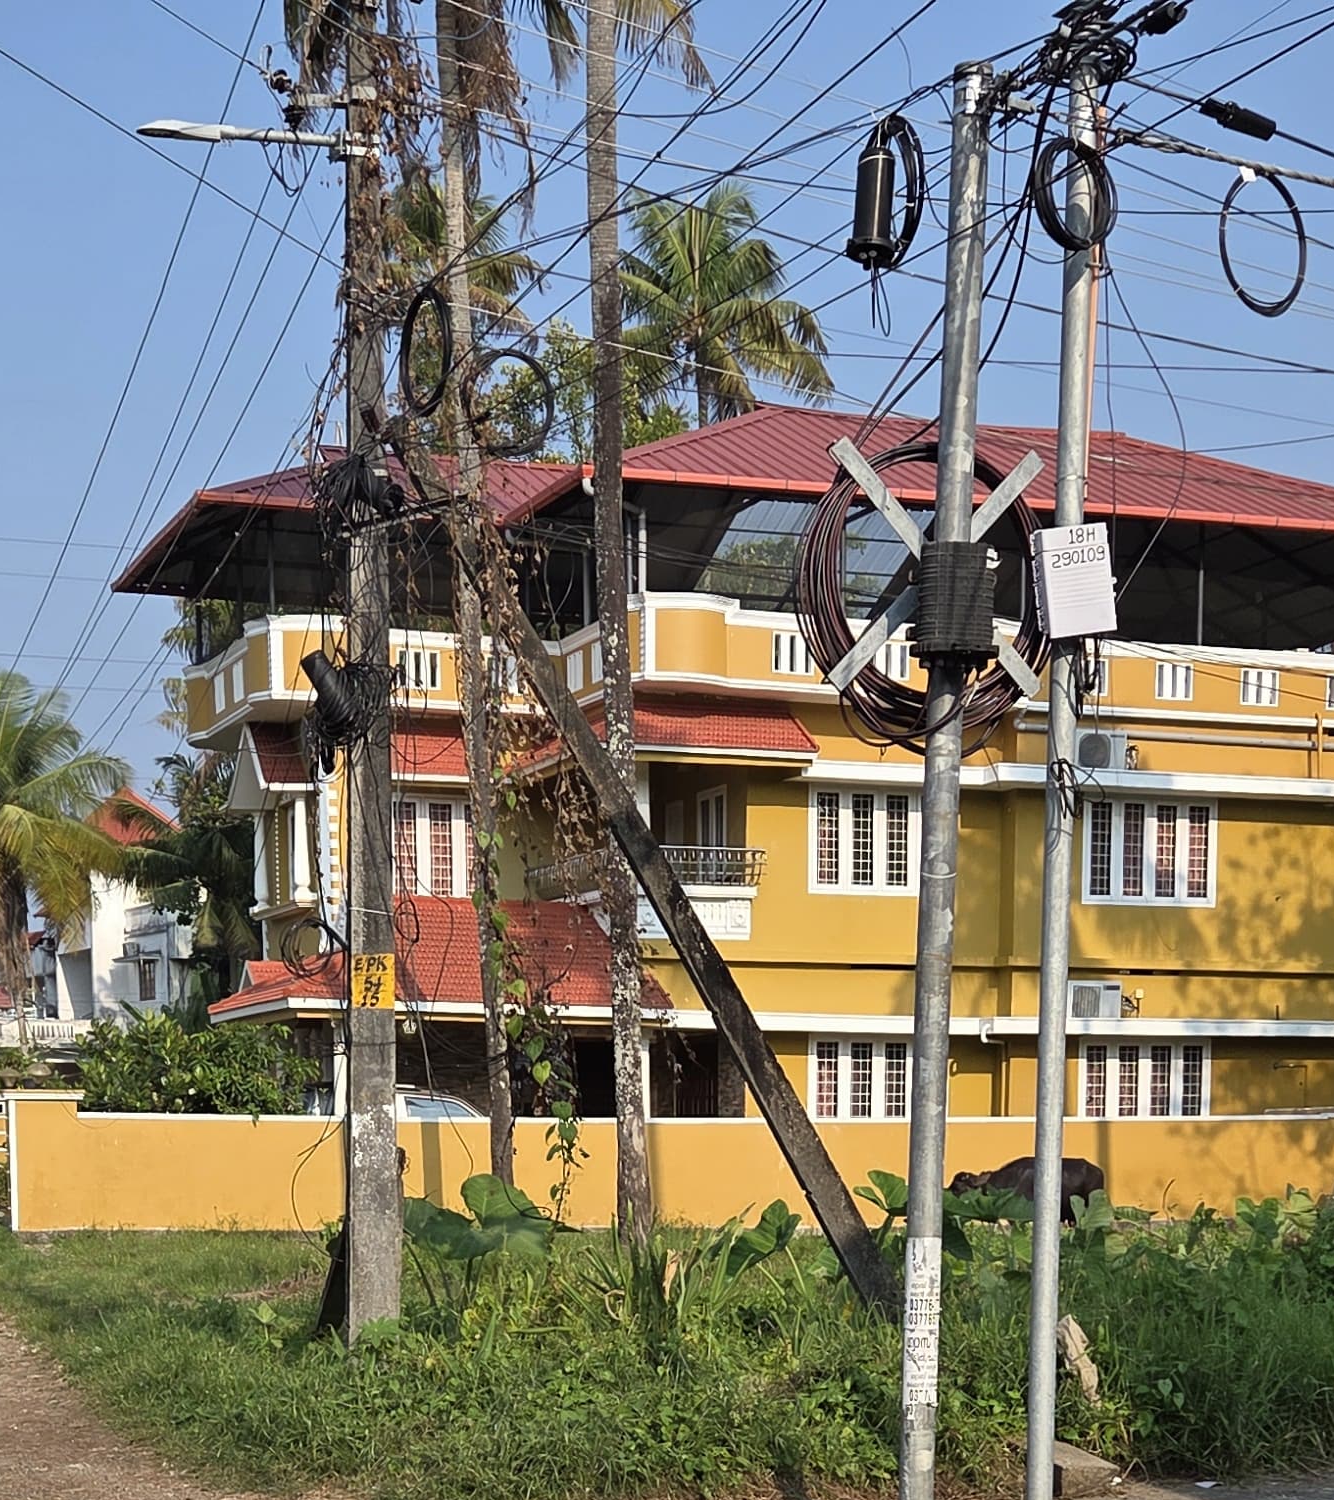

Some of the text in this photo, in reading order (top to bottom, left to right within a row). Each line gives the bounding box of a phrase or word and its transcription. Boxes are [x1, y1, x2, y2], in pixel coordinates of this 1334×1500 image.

[1068, 528, 1096, 544] 18H
[1051, 545, 1106, 569] 290109
[354, 955, 388, 972] EPK
